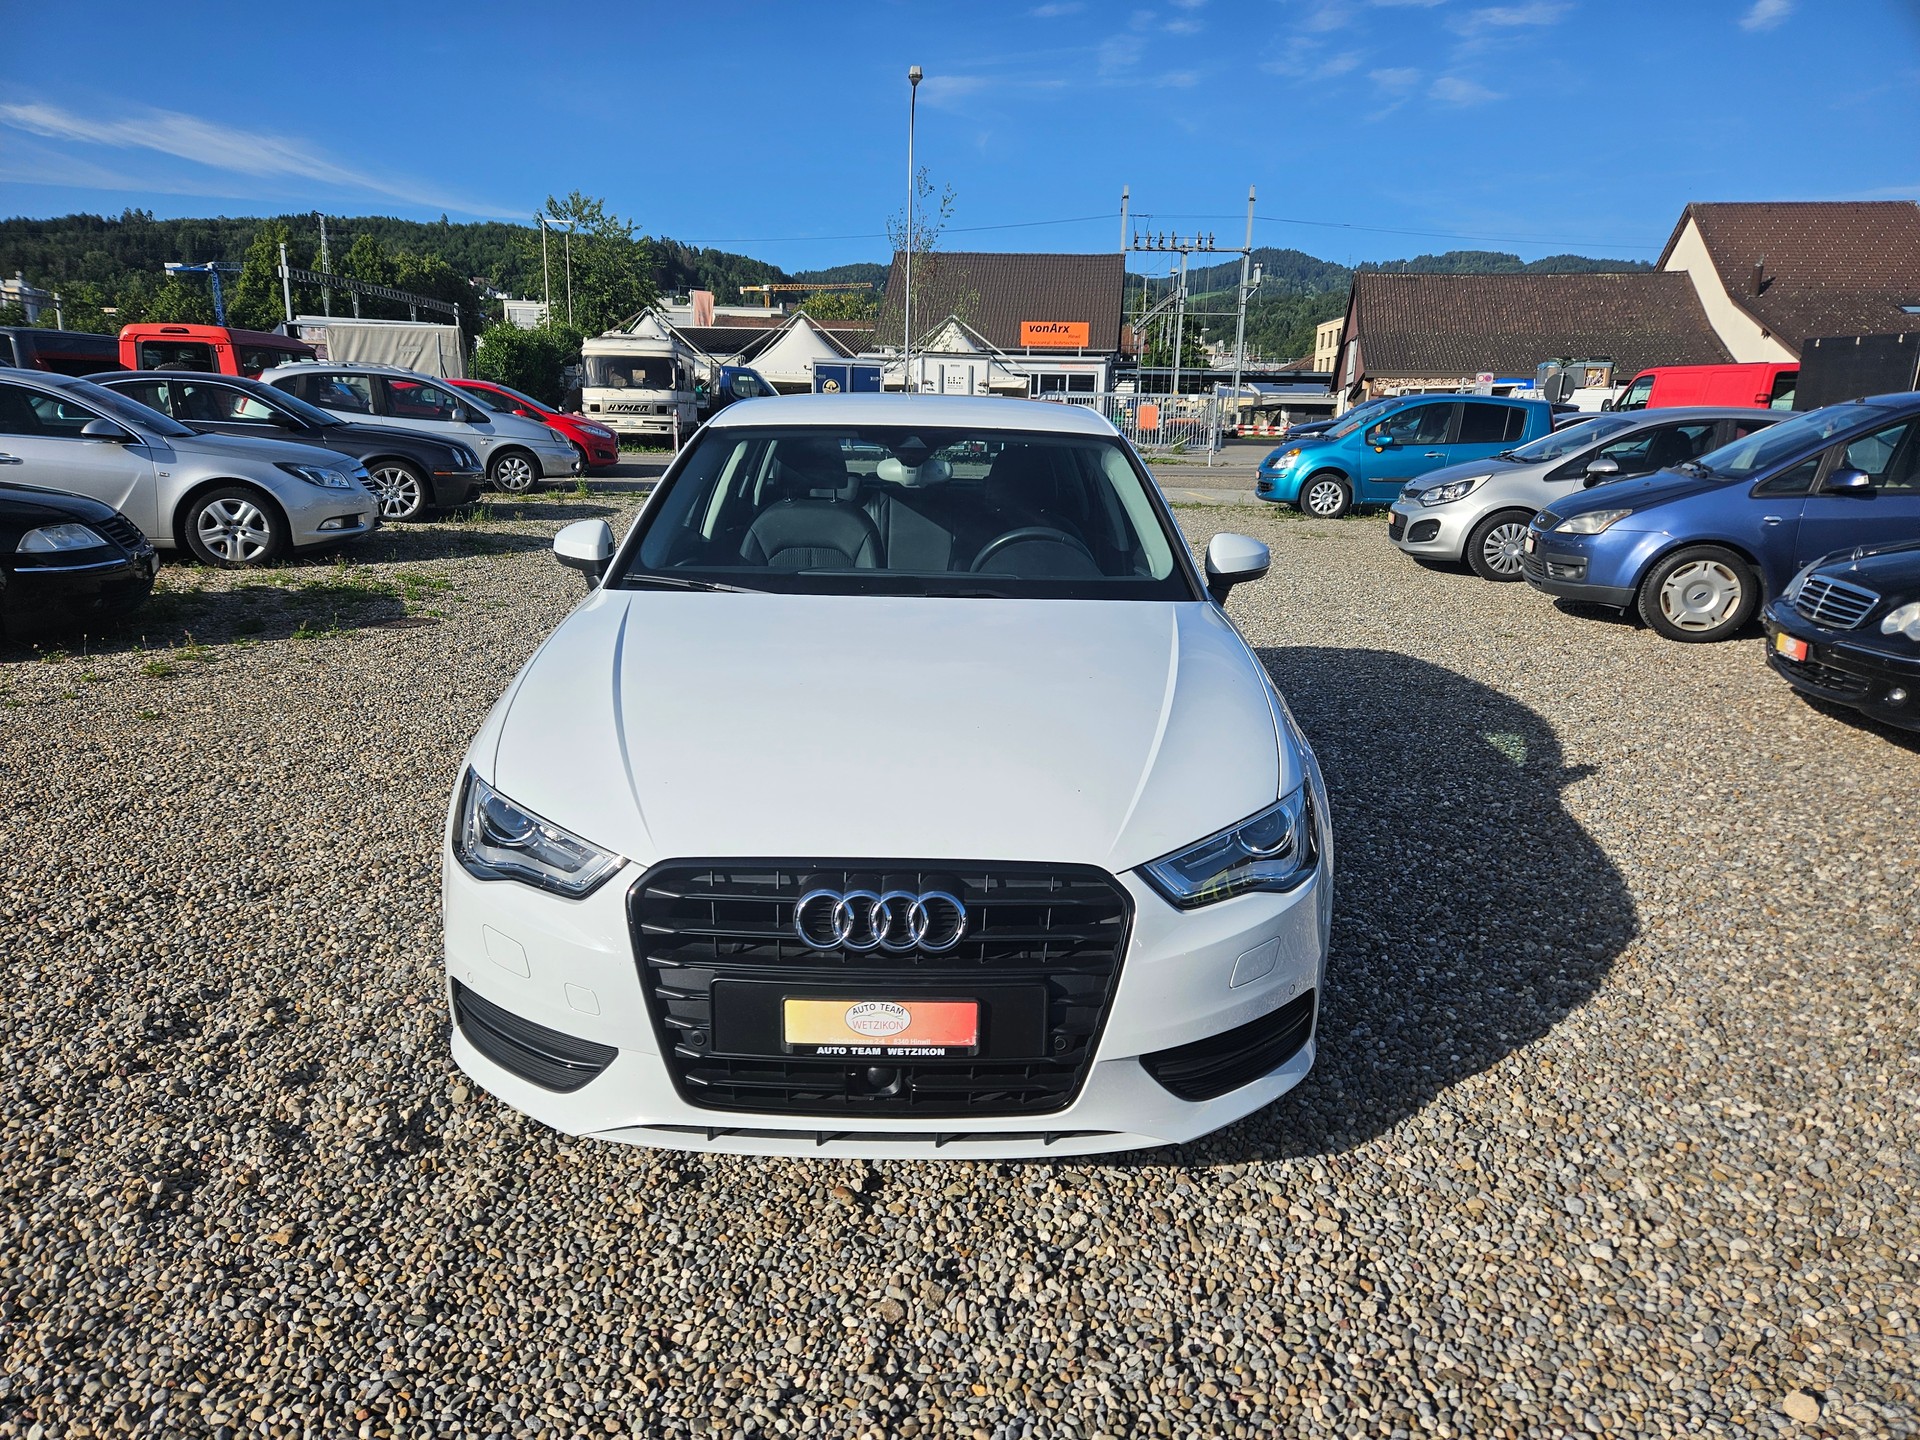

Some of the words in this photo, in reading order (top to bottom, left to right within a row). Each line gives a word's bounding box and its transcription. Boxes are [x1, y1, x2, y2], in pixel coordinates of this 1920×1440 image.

[1029, 323, 1070, 333] vonArx
[852, 1003, 876, 1015] AUTO
[880, 1003, 905, 1016] TEAM
[852, 1020, 904, 1030] WETZIKON
[816, 1046, 847, 1055] AUTO
[850, 1047, 881, 1055] TEAM
[887, 1047, 946, 1056] WETZIKON
